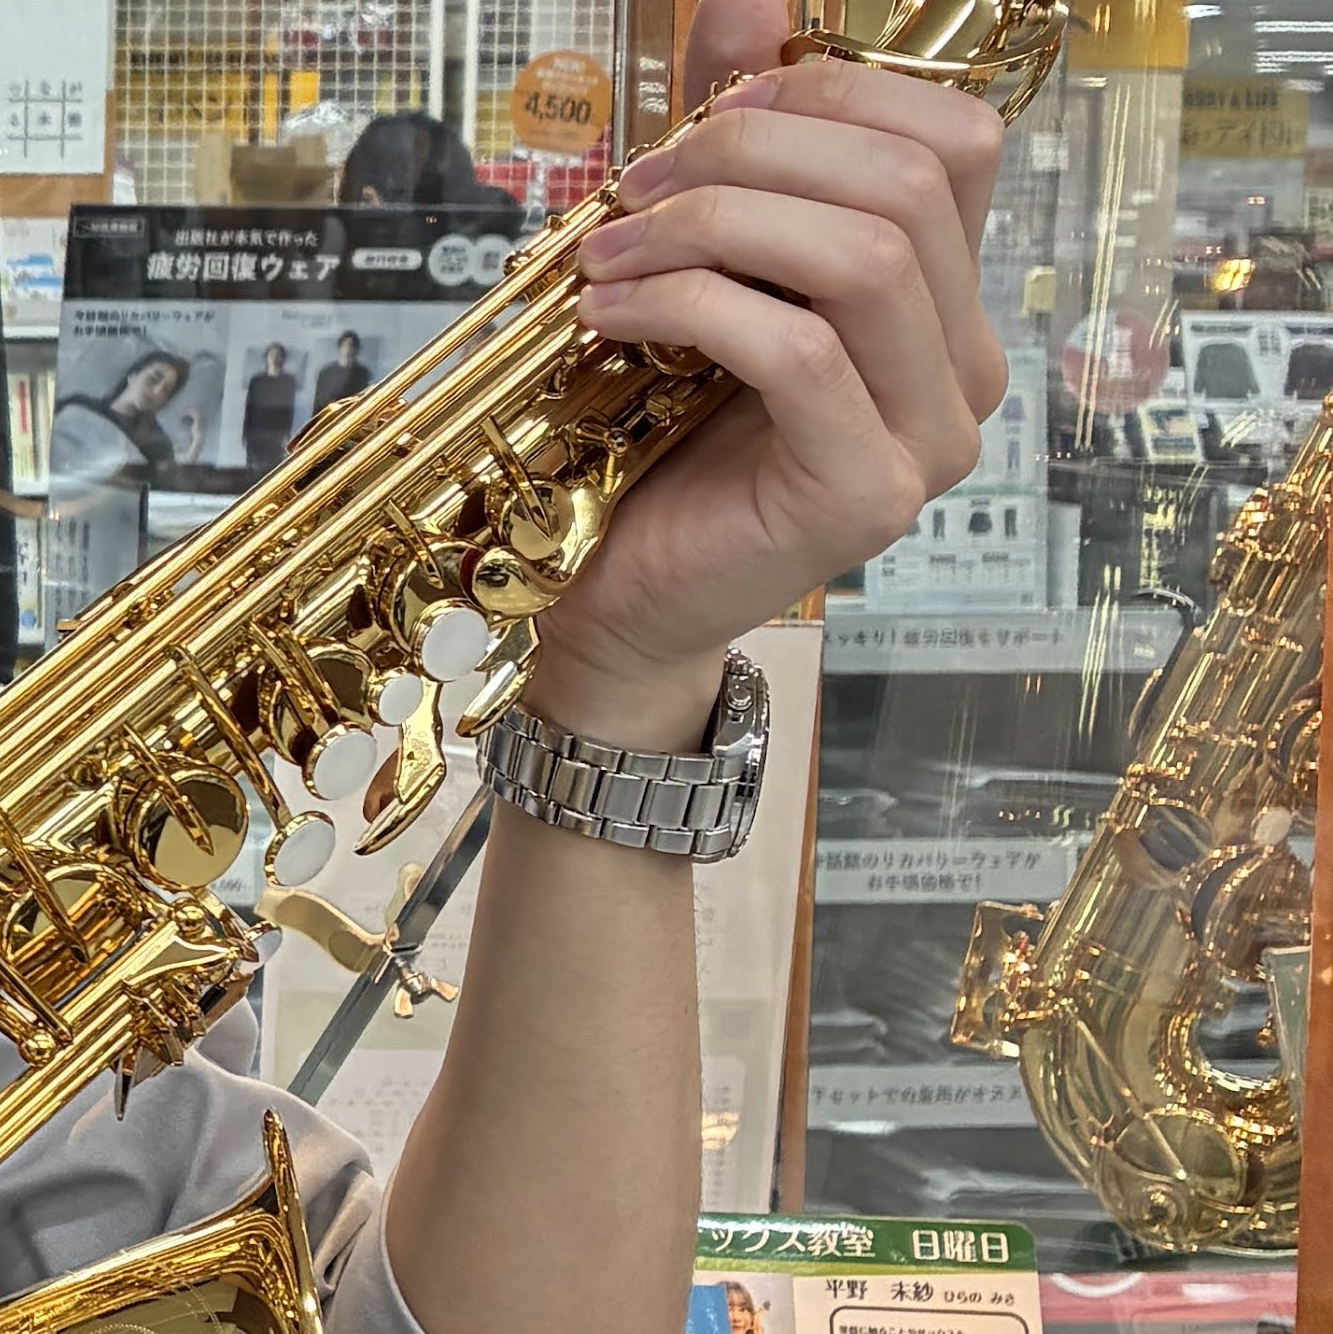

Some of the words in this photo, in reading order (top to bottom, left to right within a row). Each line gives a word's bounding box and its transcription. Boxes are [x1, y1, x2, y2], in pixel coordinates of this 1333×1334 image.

[147, 251, 340, 282] 疲労回復ウェア
[698, 1227, 876, 1258] ックス教室
[911, 1229, 1009, 1263] 日曜日
[825, 1279, 868, 1301] 平野
